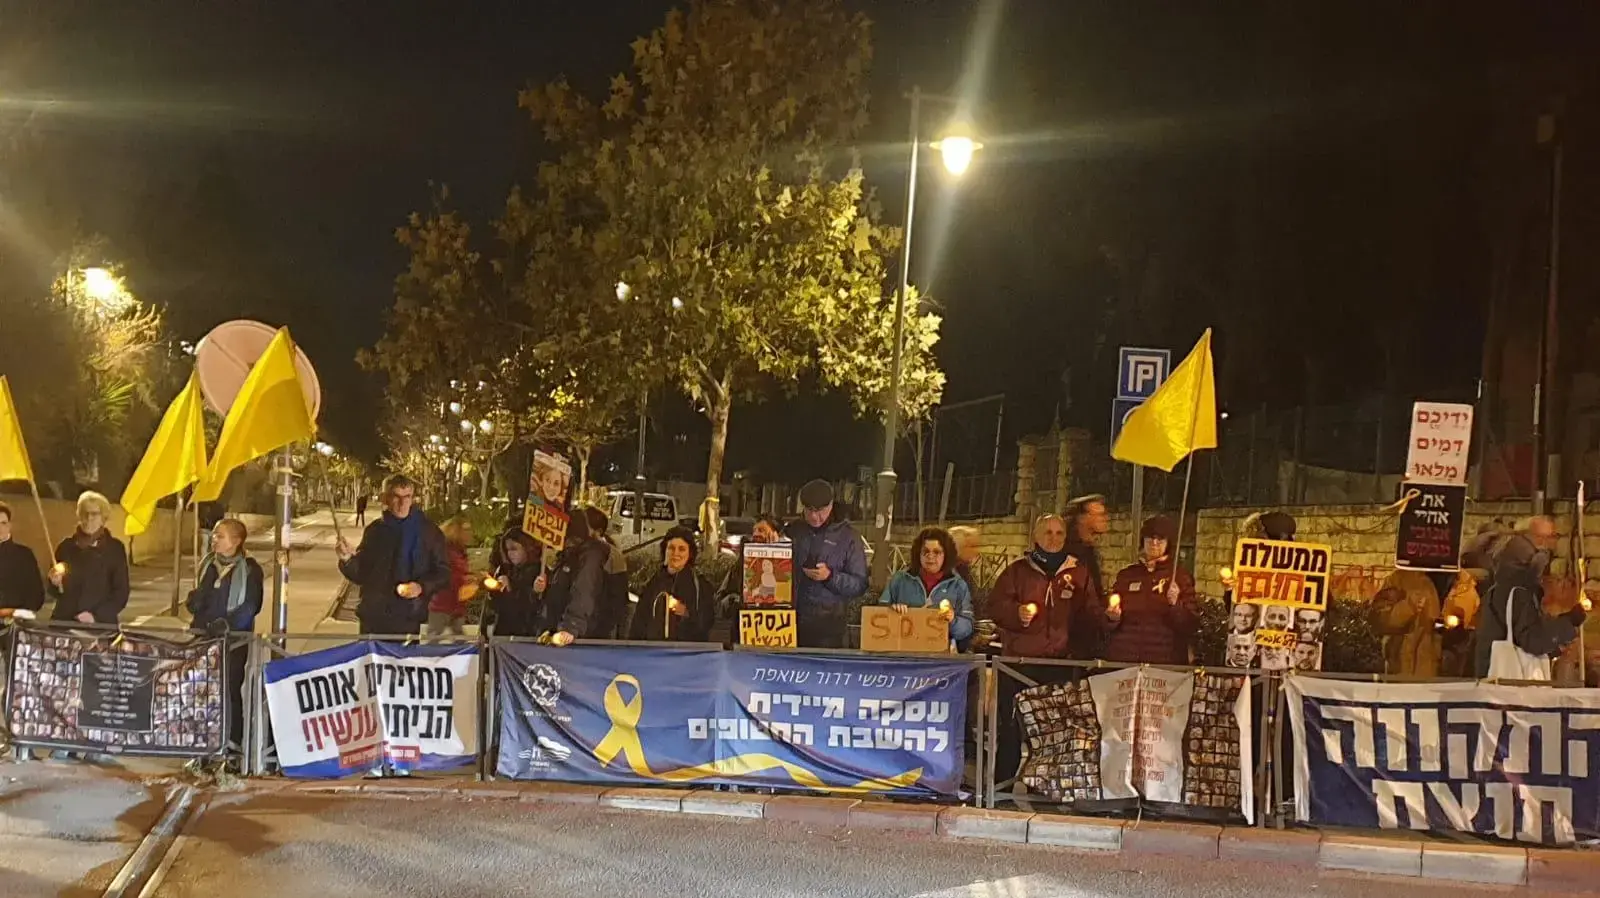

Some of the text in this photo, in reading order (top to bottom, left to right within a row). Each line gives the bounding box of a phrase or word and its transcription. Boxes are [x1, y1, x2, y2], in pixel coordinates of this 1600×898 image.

[1421, 494, 1445, 507] את
[1239, 542, 1328, 573] ממשלת
[742, 612, 791, 637] עסקה
[752, 667, 810, 684] שואפת
[816, 671, 852, 686] דרור
[858, 673, 895, 689] נפשי
[903, 675, 930, 690] עוד
[295, 663, 453, 714] מחזירים אותם
[747, 692, 949, 726] עסקה מיידית
[301, 702, 378, 752] עכשיו!
[828, 726, 949, 752] להשבת
[1372, 778, 1576, 844] תנצח
